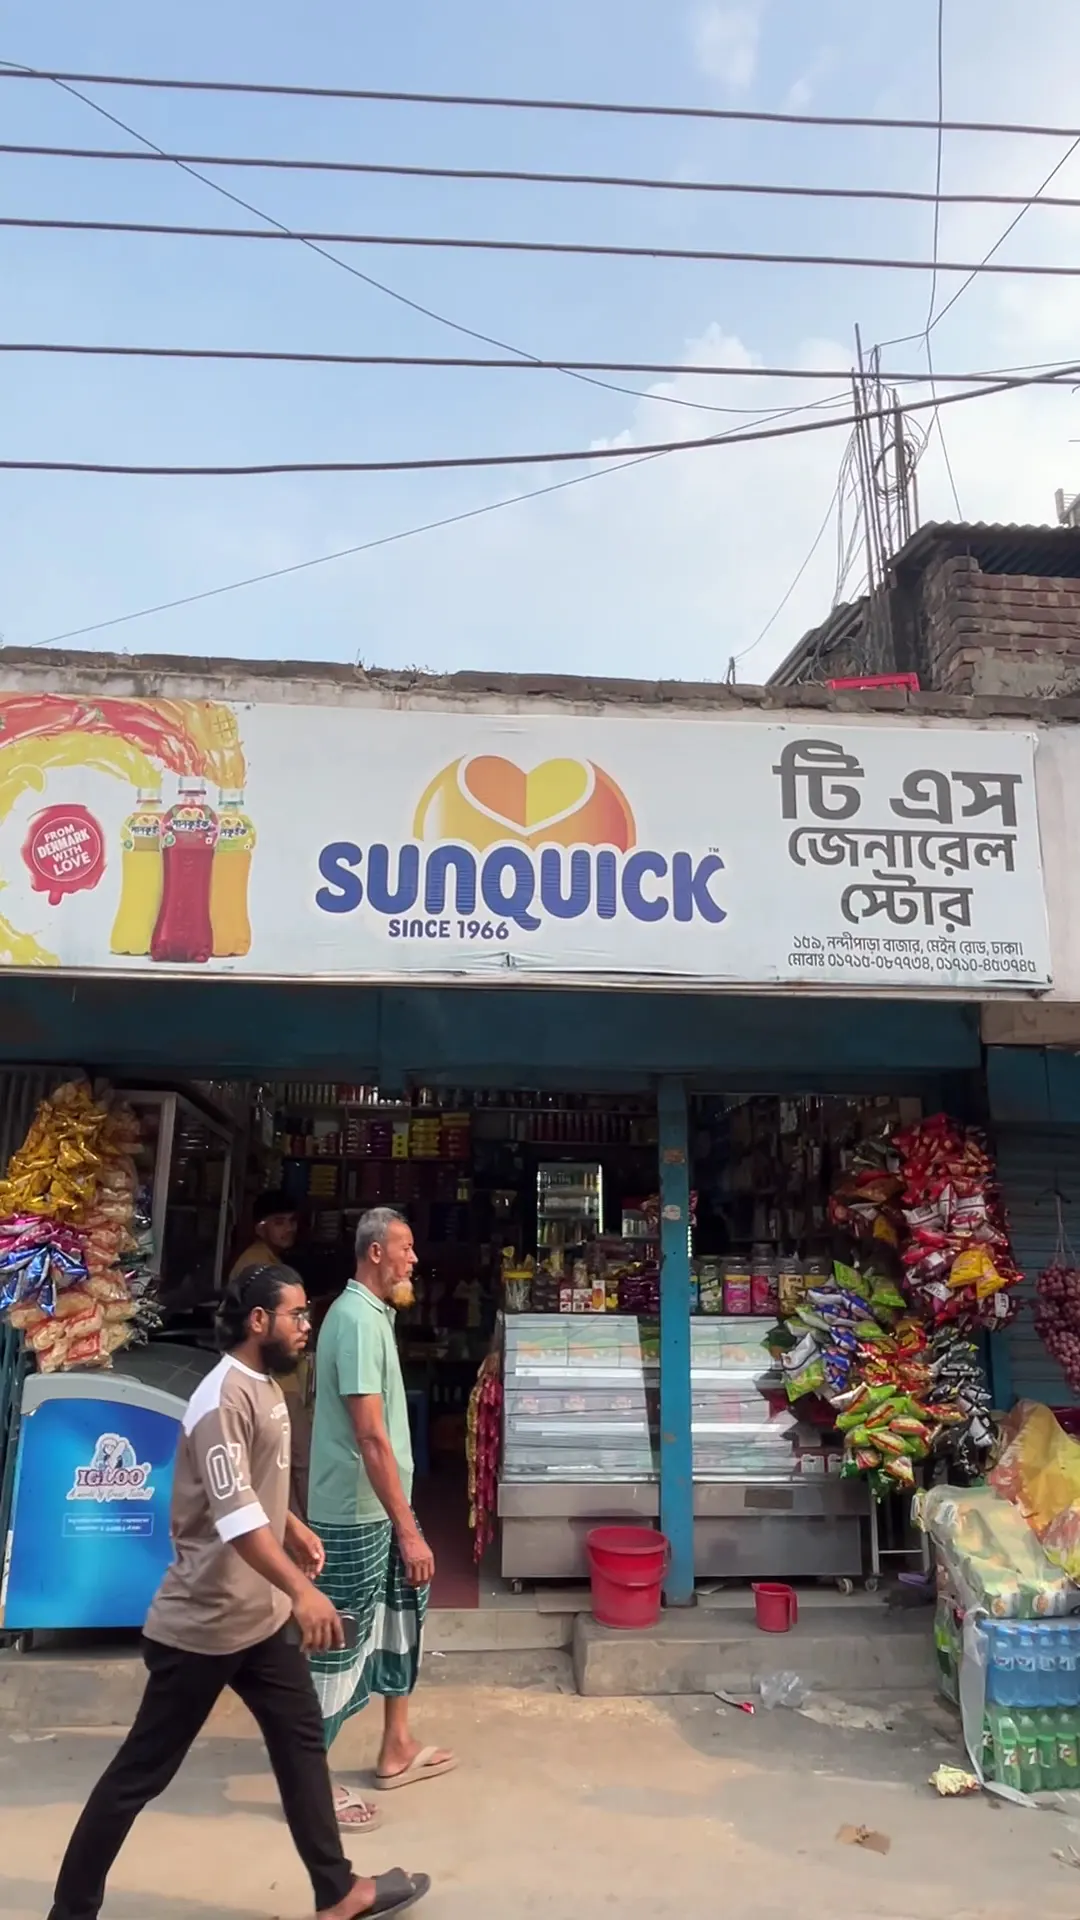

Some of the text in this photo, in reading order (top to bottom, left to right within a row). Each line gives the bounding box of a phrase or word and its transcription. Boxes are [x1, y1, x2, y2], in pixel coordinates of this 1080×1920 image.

[772, 739, 1022, 827] টি এস
[36, 828, 91, 859] DENMARK
[44, 823, 76, 843] FROM
[52, 844, 83, 863] WITH
[53, 851, 92, 876] LOVE
[788, 827, 1017, 876] জেনারেল
[315, 841, 728, 931] SUNQUICK
[841, 869, 973, 933] স্টোর
[388, 919, 510, 940] SINCE 1966
[826, 931, 880, 954] নন্দীপাড়া
[926, 935, 956, 954] মেইন
[77, 1468, 145, 1487] IGLOO
